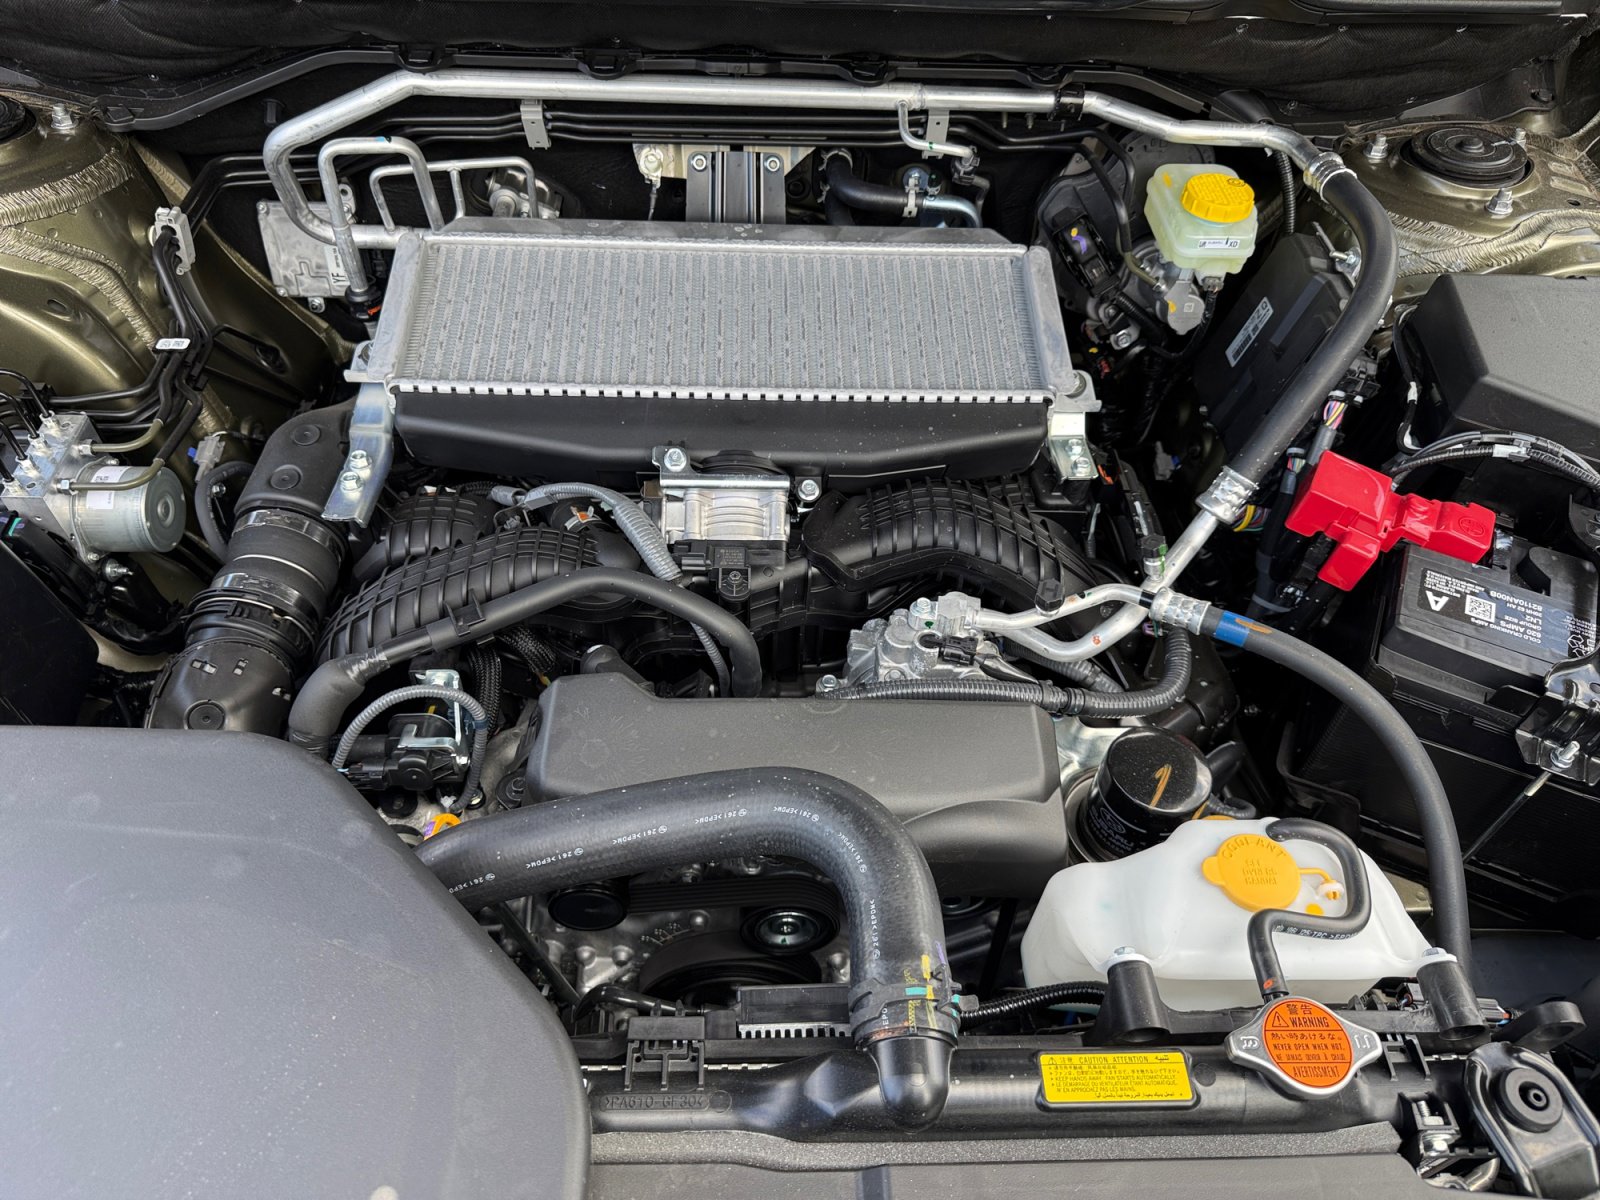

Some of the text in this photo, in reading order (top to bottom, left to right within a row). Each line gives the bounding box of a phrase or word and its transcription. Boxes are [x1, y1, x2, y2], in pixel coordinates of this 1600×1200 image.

[1526, 615, 1542, 625] LN2
[1500, 621, 1541, 638] 620 AMPS
[556, 850, 572, 859] 261
[1286, 1004, 1312, 1015] 警告
[1289, 1017, 1329, 1028] WARNING
[1079, 1056, 1109, 1064] CAUTION
